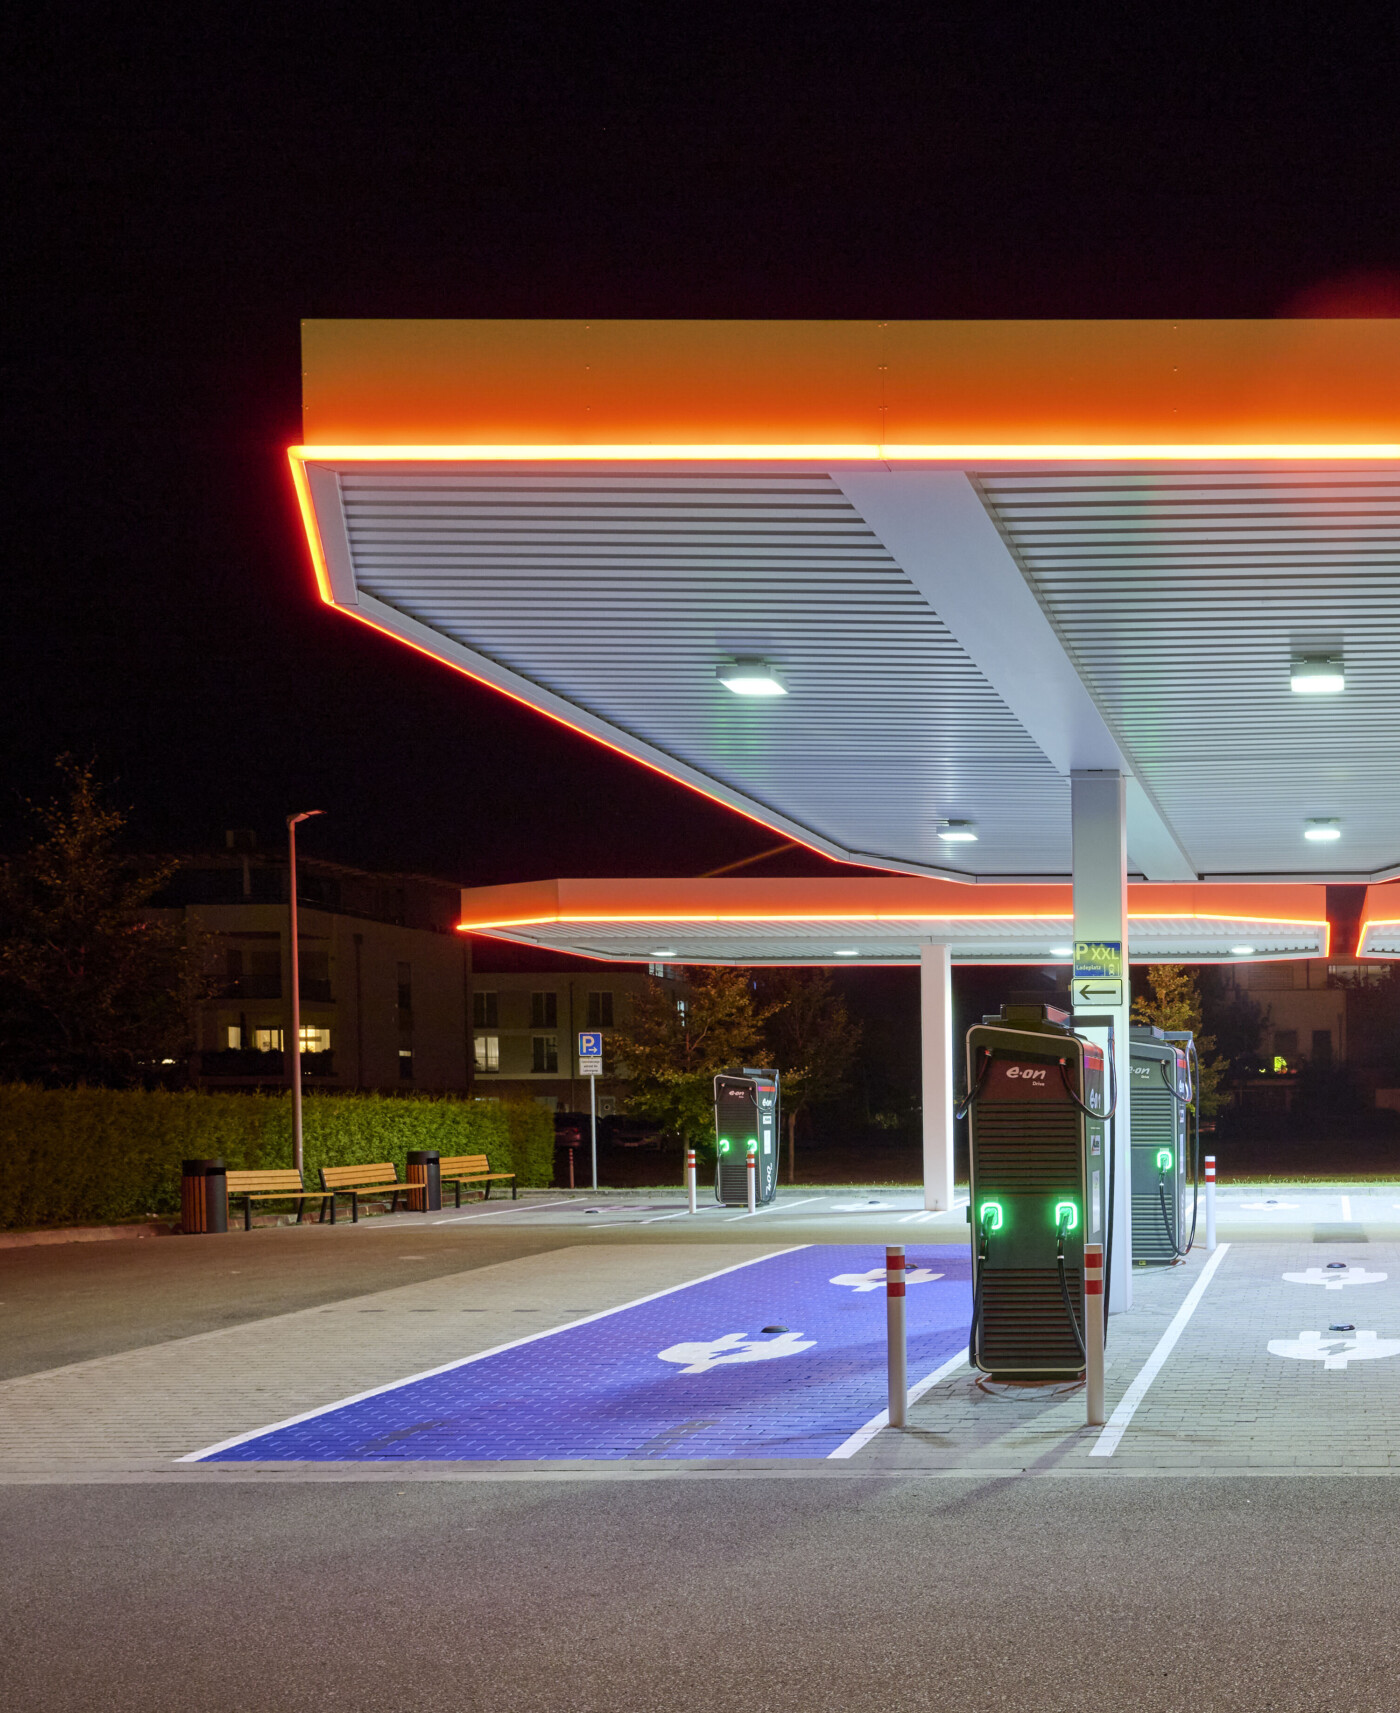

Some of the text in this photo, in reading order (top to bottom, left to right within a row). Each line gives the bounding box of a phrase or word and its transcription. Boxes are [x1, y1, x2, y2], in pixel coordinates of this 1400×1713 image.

[1076, 943, 1119, 960] P XXL
[582, 1035, 595, 1053] P
